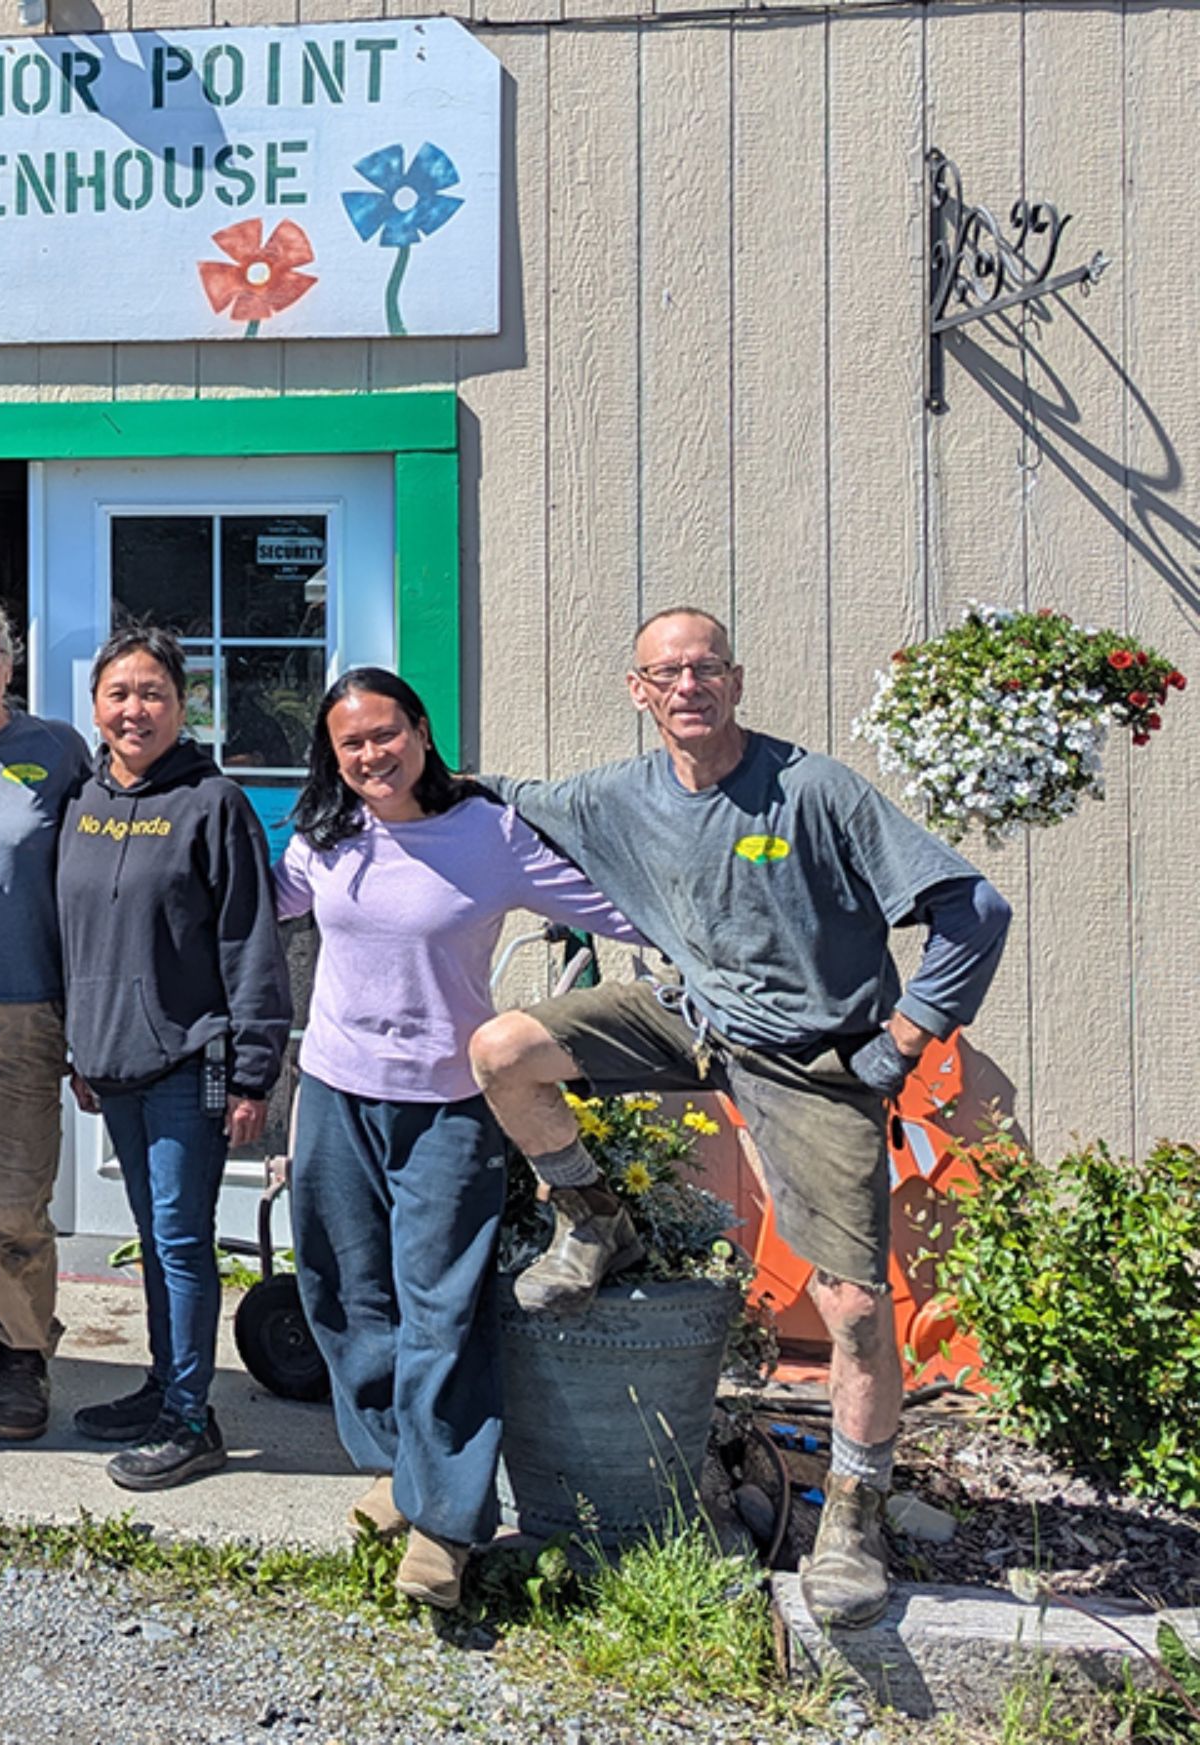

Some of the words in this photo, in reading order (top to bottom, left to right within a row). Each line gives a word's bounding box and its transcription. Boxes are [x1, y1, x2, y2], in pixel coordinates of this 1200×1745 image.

[152, 38, 398, 109] POINT
[259, 545, 323, 560] SECURITY
[77, 814, 101, 834] No
